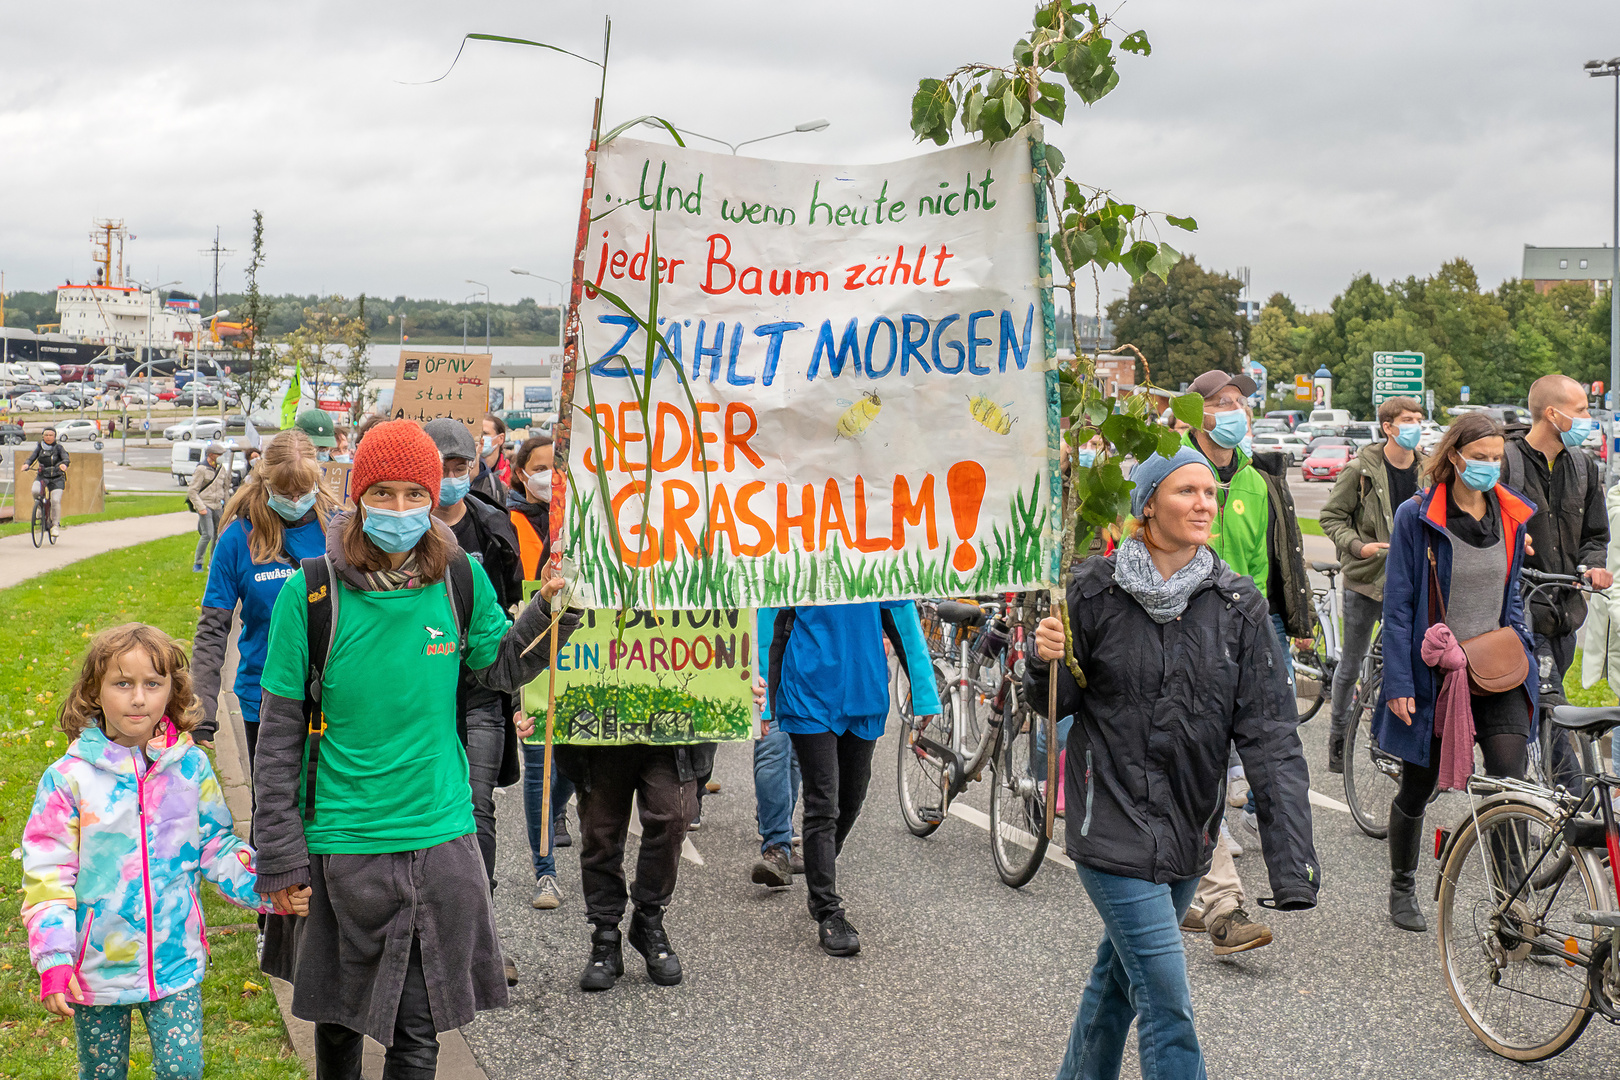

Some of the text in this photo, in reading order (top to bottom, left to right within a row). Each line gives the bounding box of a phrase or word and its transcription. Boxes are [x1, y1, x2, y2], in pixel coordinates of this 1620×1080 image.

[721, 196, 797, 226] wenn
[809, 180, 908, 226] heute
[918, 168, 998, 218] nicht
[585, 230, 955, 300] jeder Baum zählt
[425, 356, 474, 373] ÖPNV
[590, 302, 1035, 387] ZÄHLT MORGEN
[415, 386, 463, 400] statt
[583, 401, 766, 473] JEDER
[254, 568, 297, 582] GEWÄSS
[546, 632, 750, 681] EIN PARDON!
